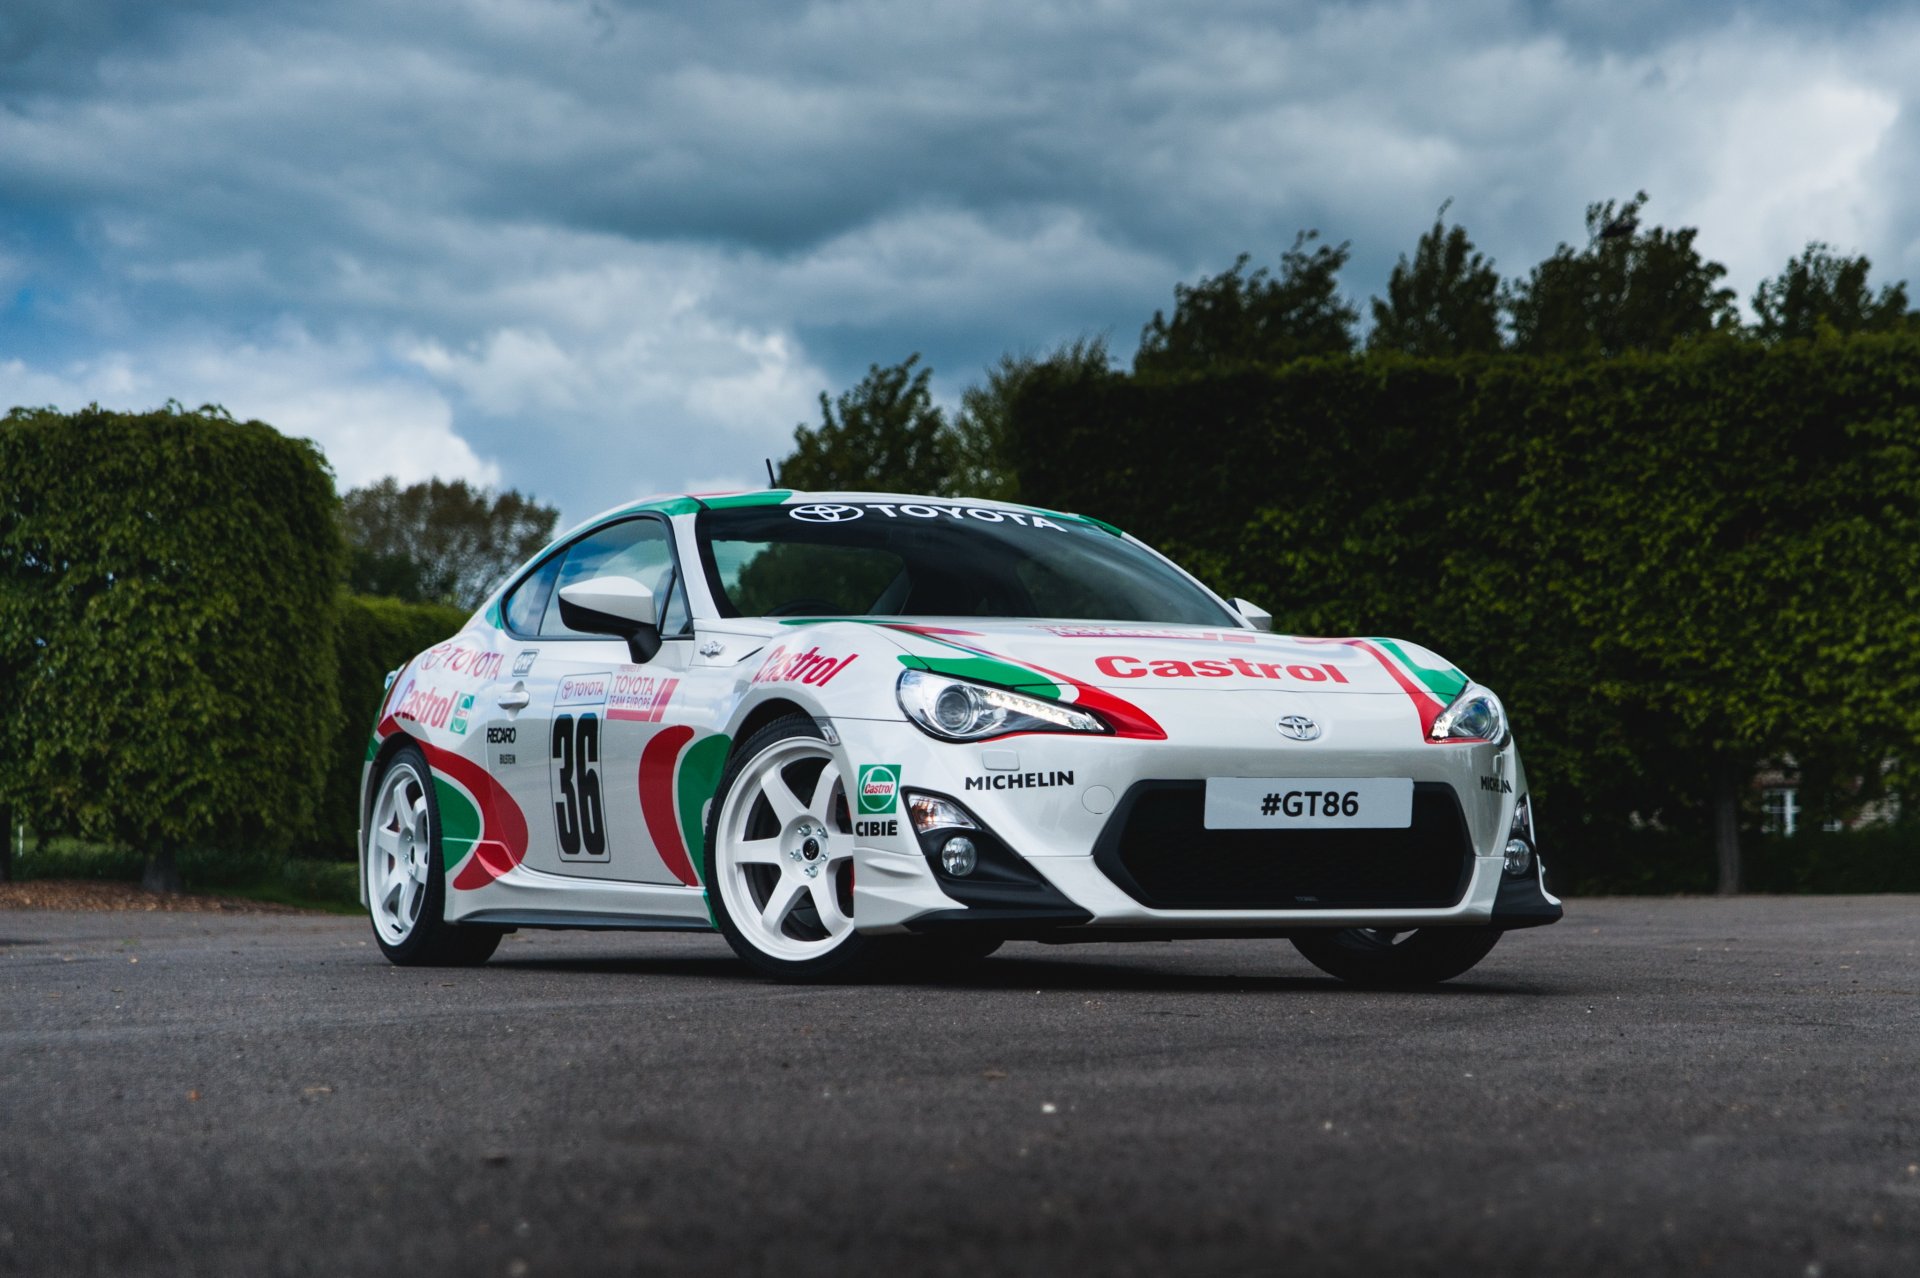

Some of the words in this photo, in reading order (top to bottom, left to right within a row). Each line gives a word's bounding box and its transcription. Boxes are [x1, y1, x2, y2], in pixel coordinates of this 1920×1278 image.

[866, 504, 1068, 532] TOYOTA
[444, 648, 504, 680] TOYOTA
[752, 645, 859, 687] Castrol
[1095, 656, 1350, 684] Castrol
[574, 681, 604, 697] TOYOTA
[613, 675, 655, 696] TOYOTA
[395, 679, 458, 729] Castrol
[609, 695, 626, 707] TEAM
[626, 696, 651, 709] EUROPE
[487, 727, 516, 744] RECARO
[552, 713, 605, 855] 36
[864, 783, 893, 794] Castrol
[965, 771, 1074, 790] MICHELIN
[1260, 791, 1360, 817] #GT86
